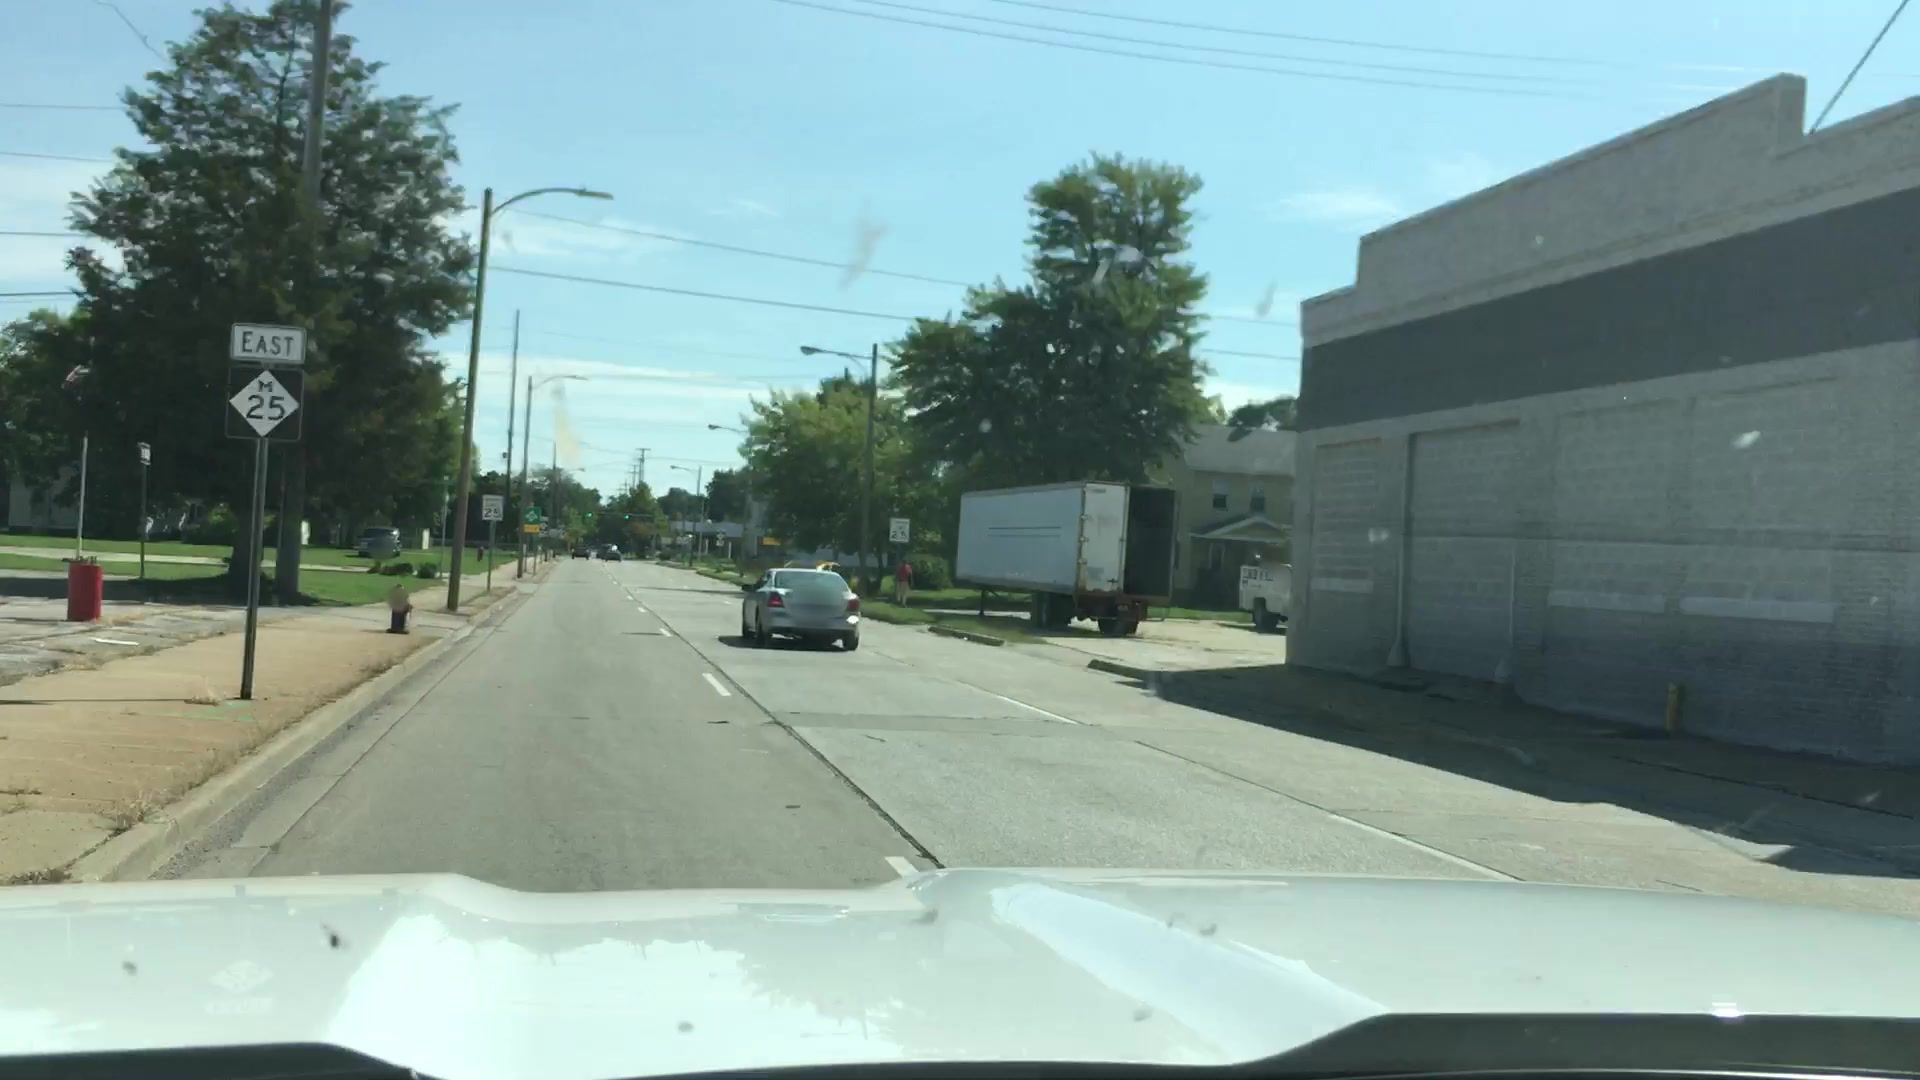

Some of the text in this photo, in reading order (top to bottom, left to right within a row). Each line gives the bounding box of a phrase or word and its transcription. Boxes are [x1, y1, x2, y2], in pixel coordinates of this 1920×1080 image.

[242, 331, 294, 356] EAST
[258, 380, 273, 392] M
[246, 394, 285, 420] 25
